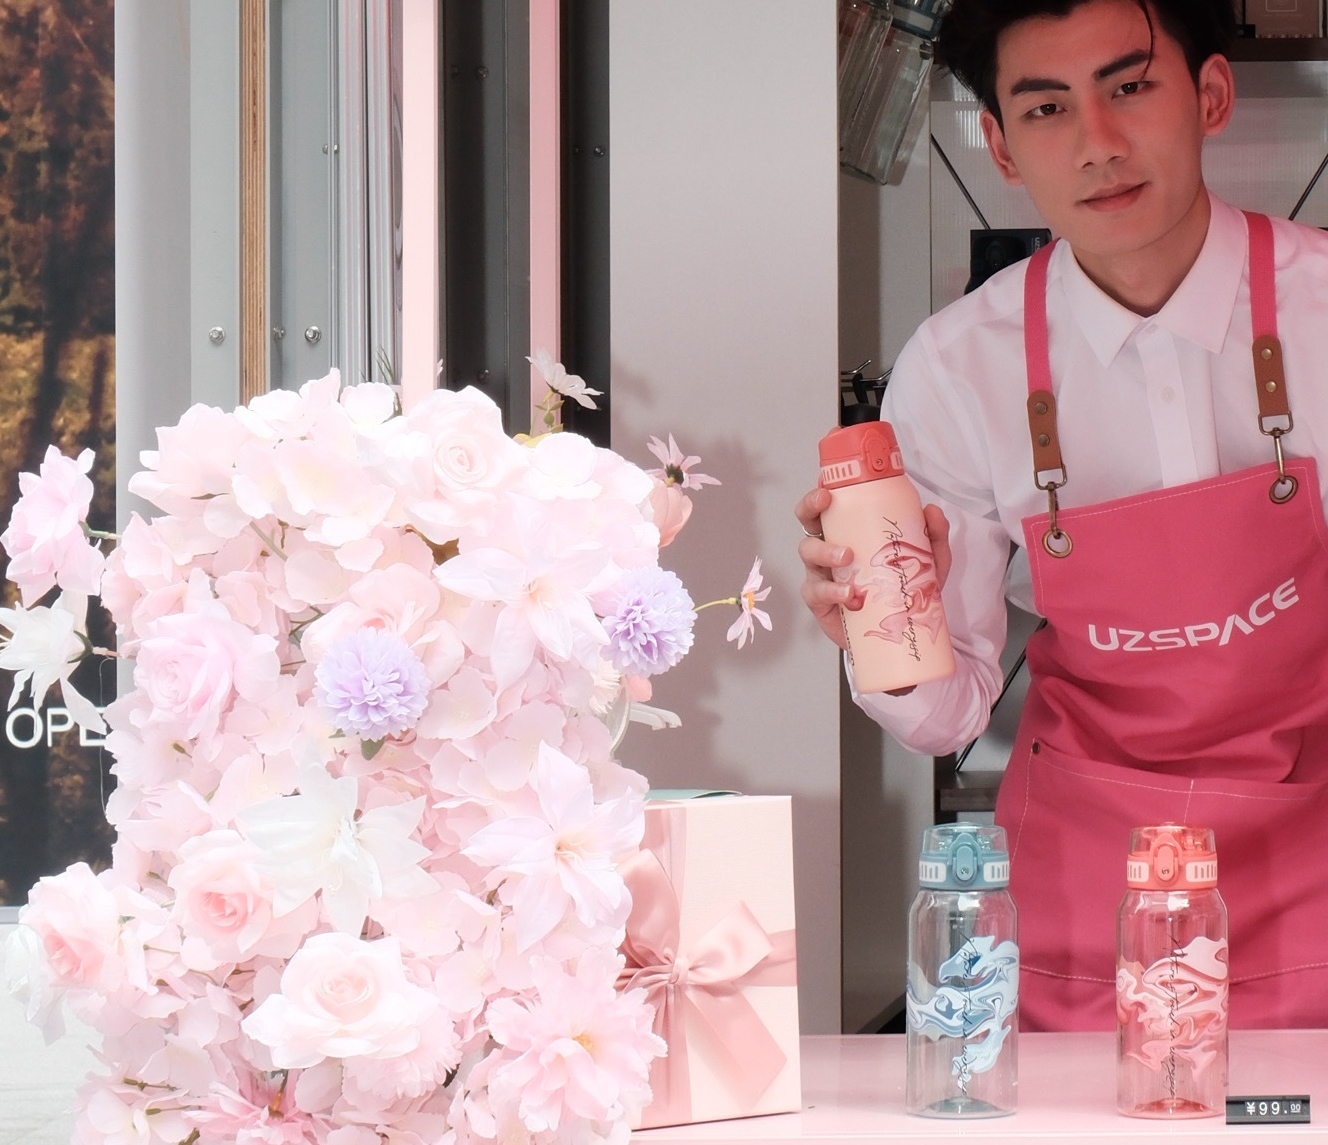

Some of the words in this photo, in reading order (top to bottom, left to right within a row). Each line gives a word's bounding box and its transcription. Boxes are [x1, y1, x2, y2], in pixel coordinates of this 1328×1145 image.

[1088, 577, 1300, 652] UZSPACE
[5, 707, 108, 748] OPE
[1246, 1101, 1301, 1116] ¥99.00
